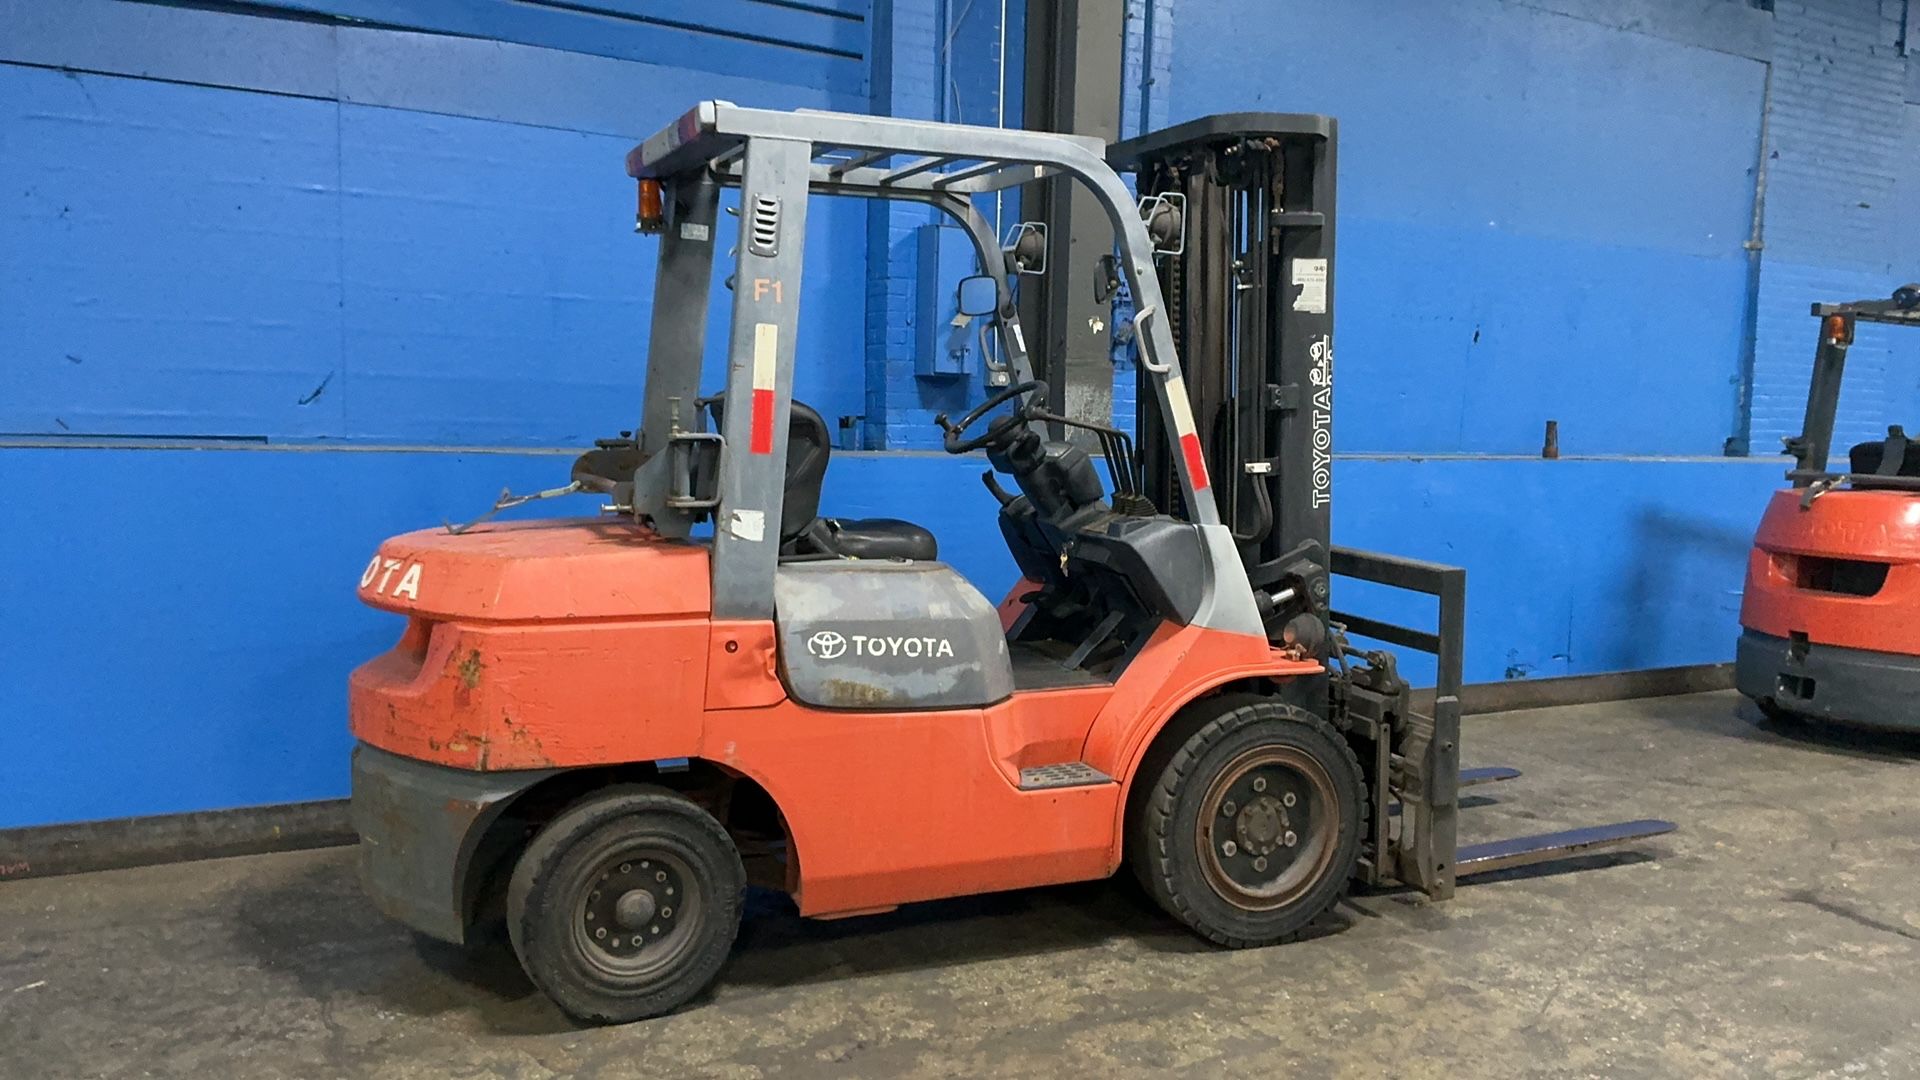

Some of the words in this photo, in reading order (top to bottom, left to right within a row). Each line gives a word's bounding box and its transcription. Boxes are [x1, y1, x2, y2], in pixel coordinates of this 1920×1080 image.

[753, 278, 783, 304] F1
[1311, 387, 1331, 509] TOYOTA
[361, 554, 424, 600] OTA
[851, 635, 954, 658] TOYOTA
